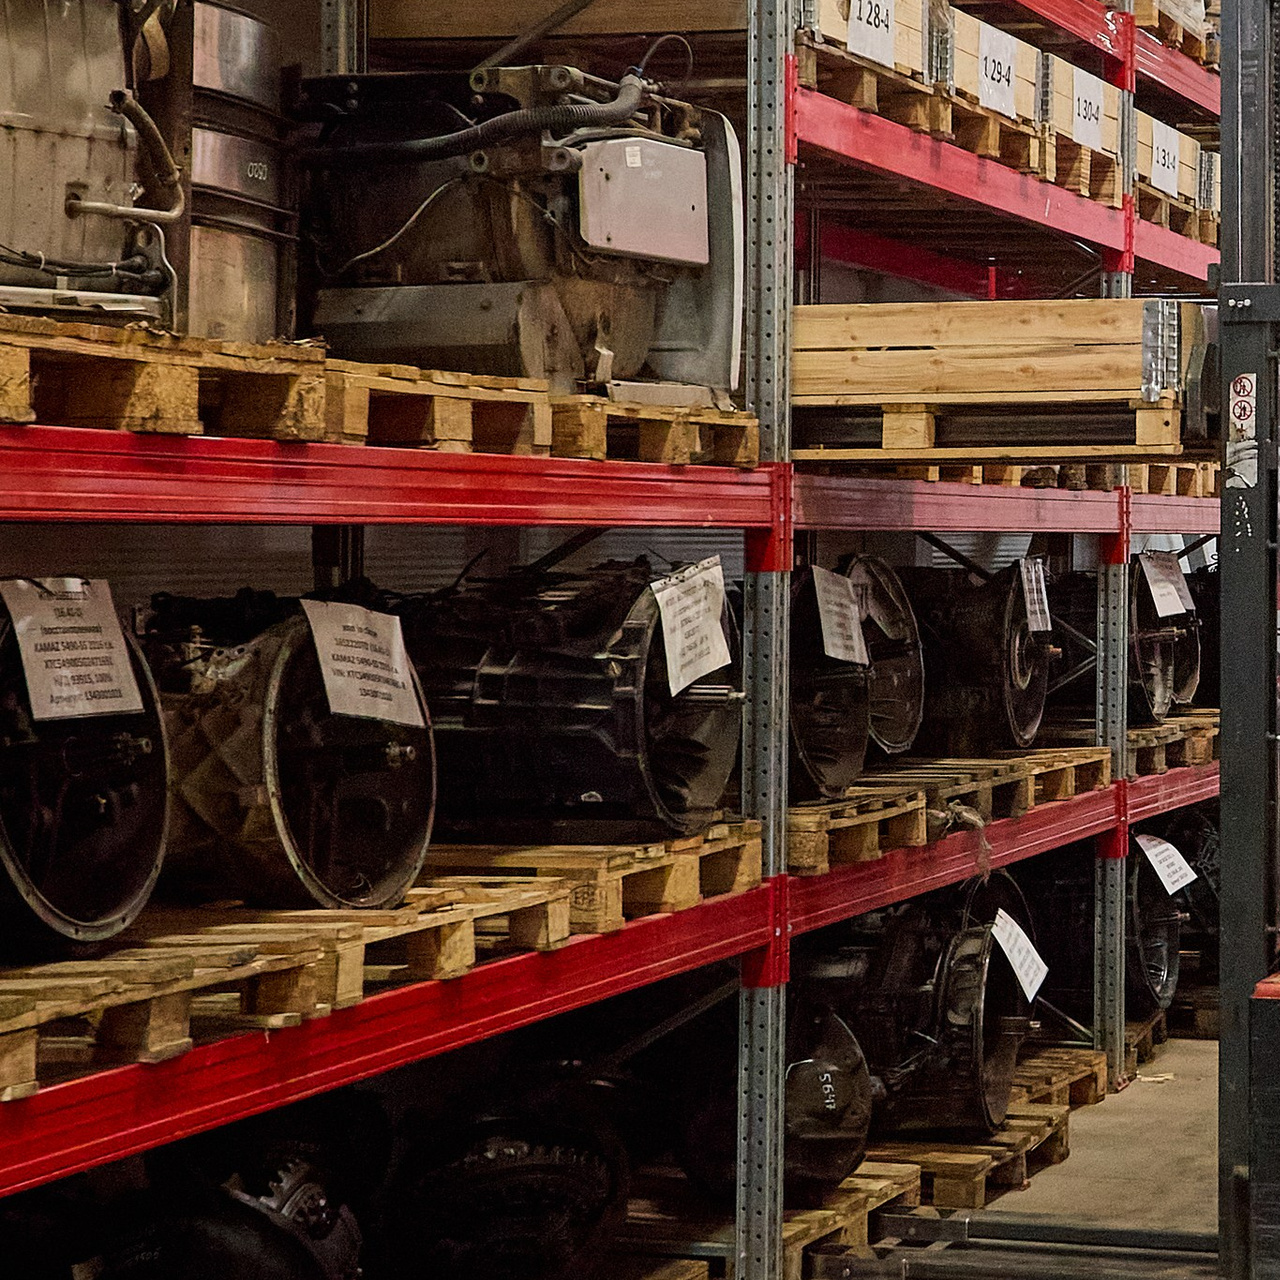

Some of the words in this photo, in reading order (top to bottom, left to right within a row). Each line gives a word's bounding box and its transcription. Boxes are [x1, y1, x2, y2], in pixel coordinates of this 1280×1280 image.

[865, 3, 890, 34] 28-4
[983, 55, 989, 79] 1
[991, 59, 1012, 87] 29-4
[1082, 99, 1100, 125] 30-4
